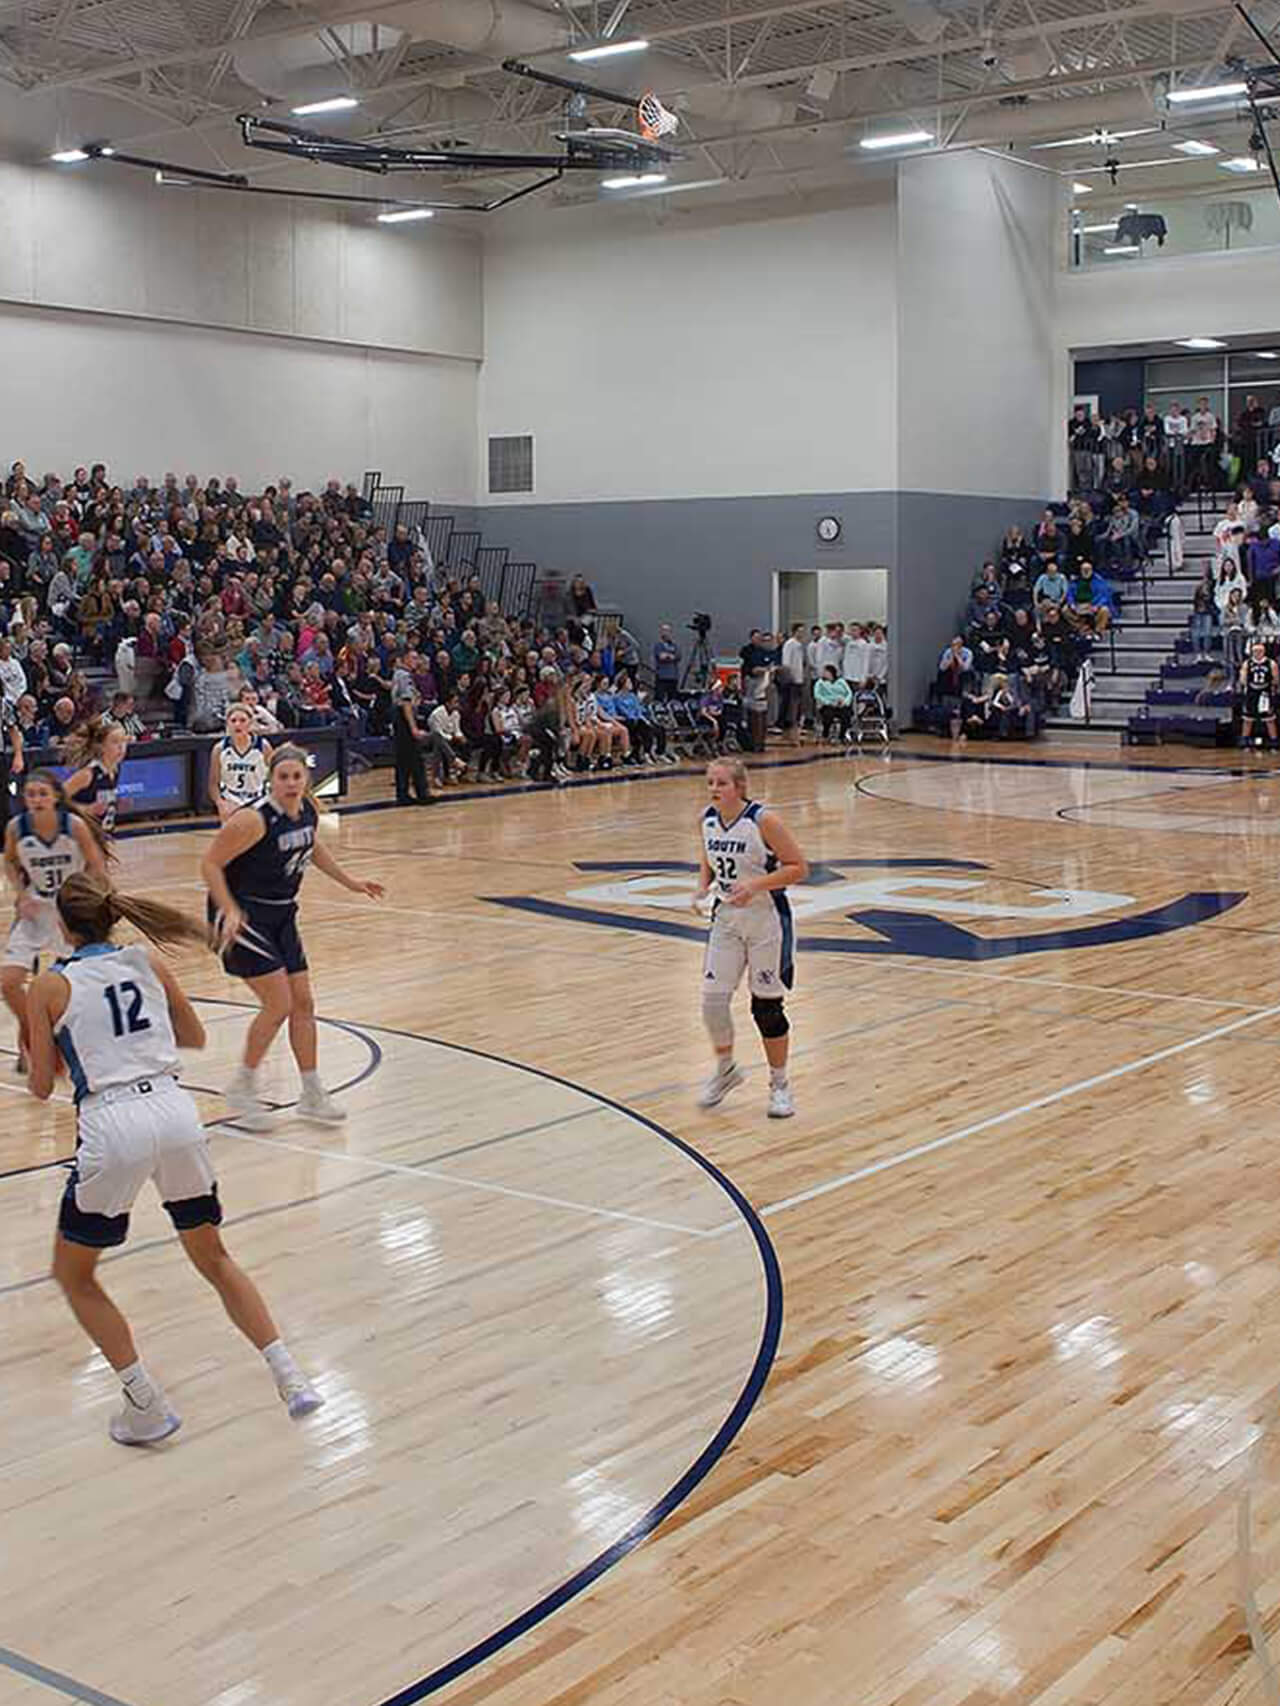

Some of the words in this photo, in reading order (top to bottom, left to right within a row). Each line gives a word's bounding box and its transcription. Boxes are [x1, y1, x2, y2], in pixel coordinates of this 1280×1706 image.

[237, 774, 246, 789] 5
[708, 839, 747, 854] SOUTH
[43, 868, 65, 889] 31
[716, 857, 738, 880] 32
[103, 981, 152, 1037] 12
